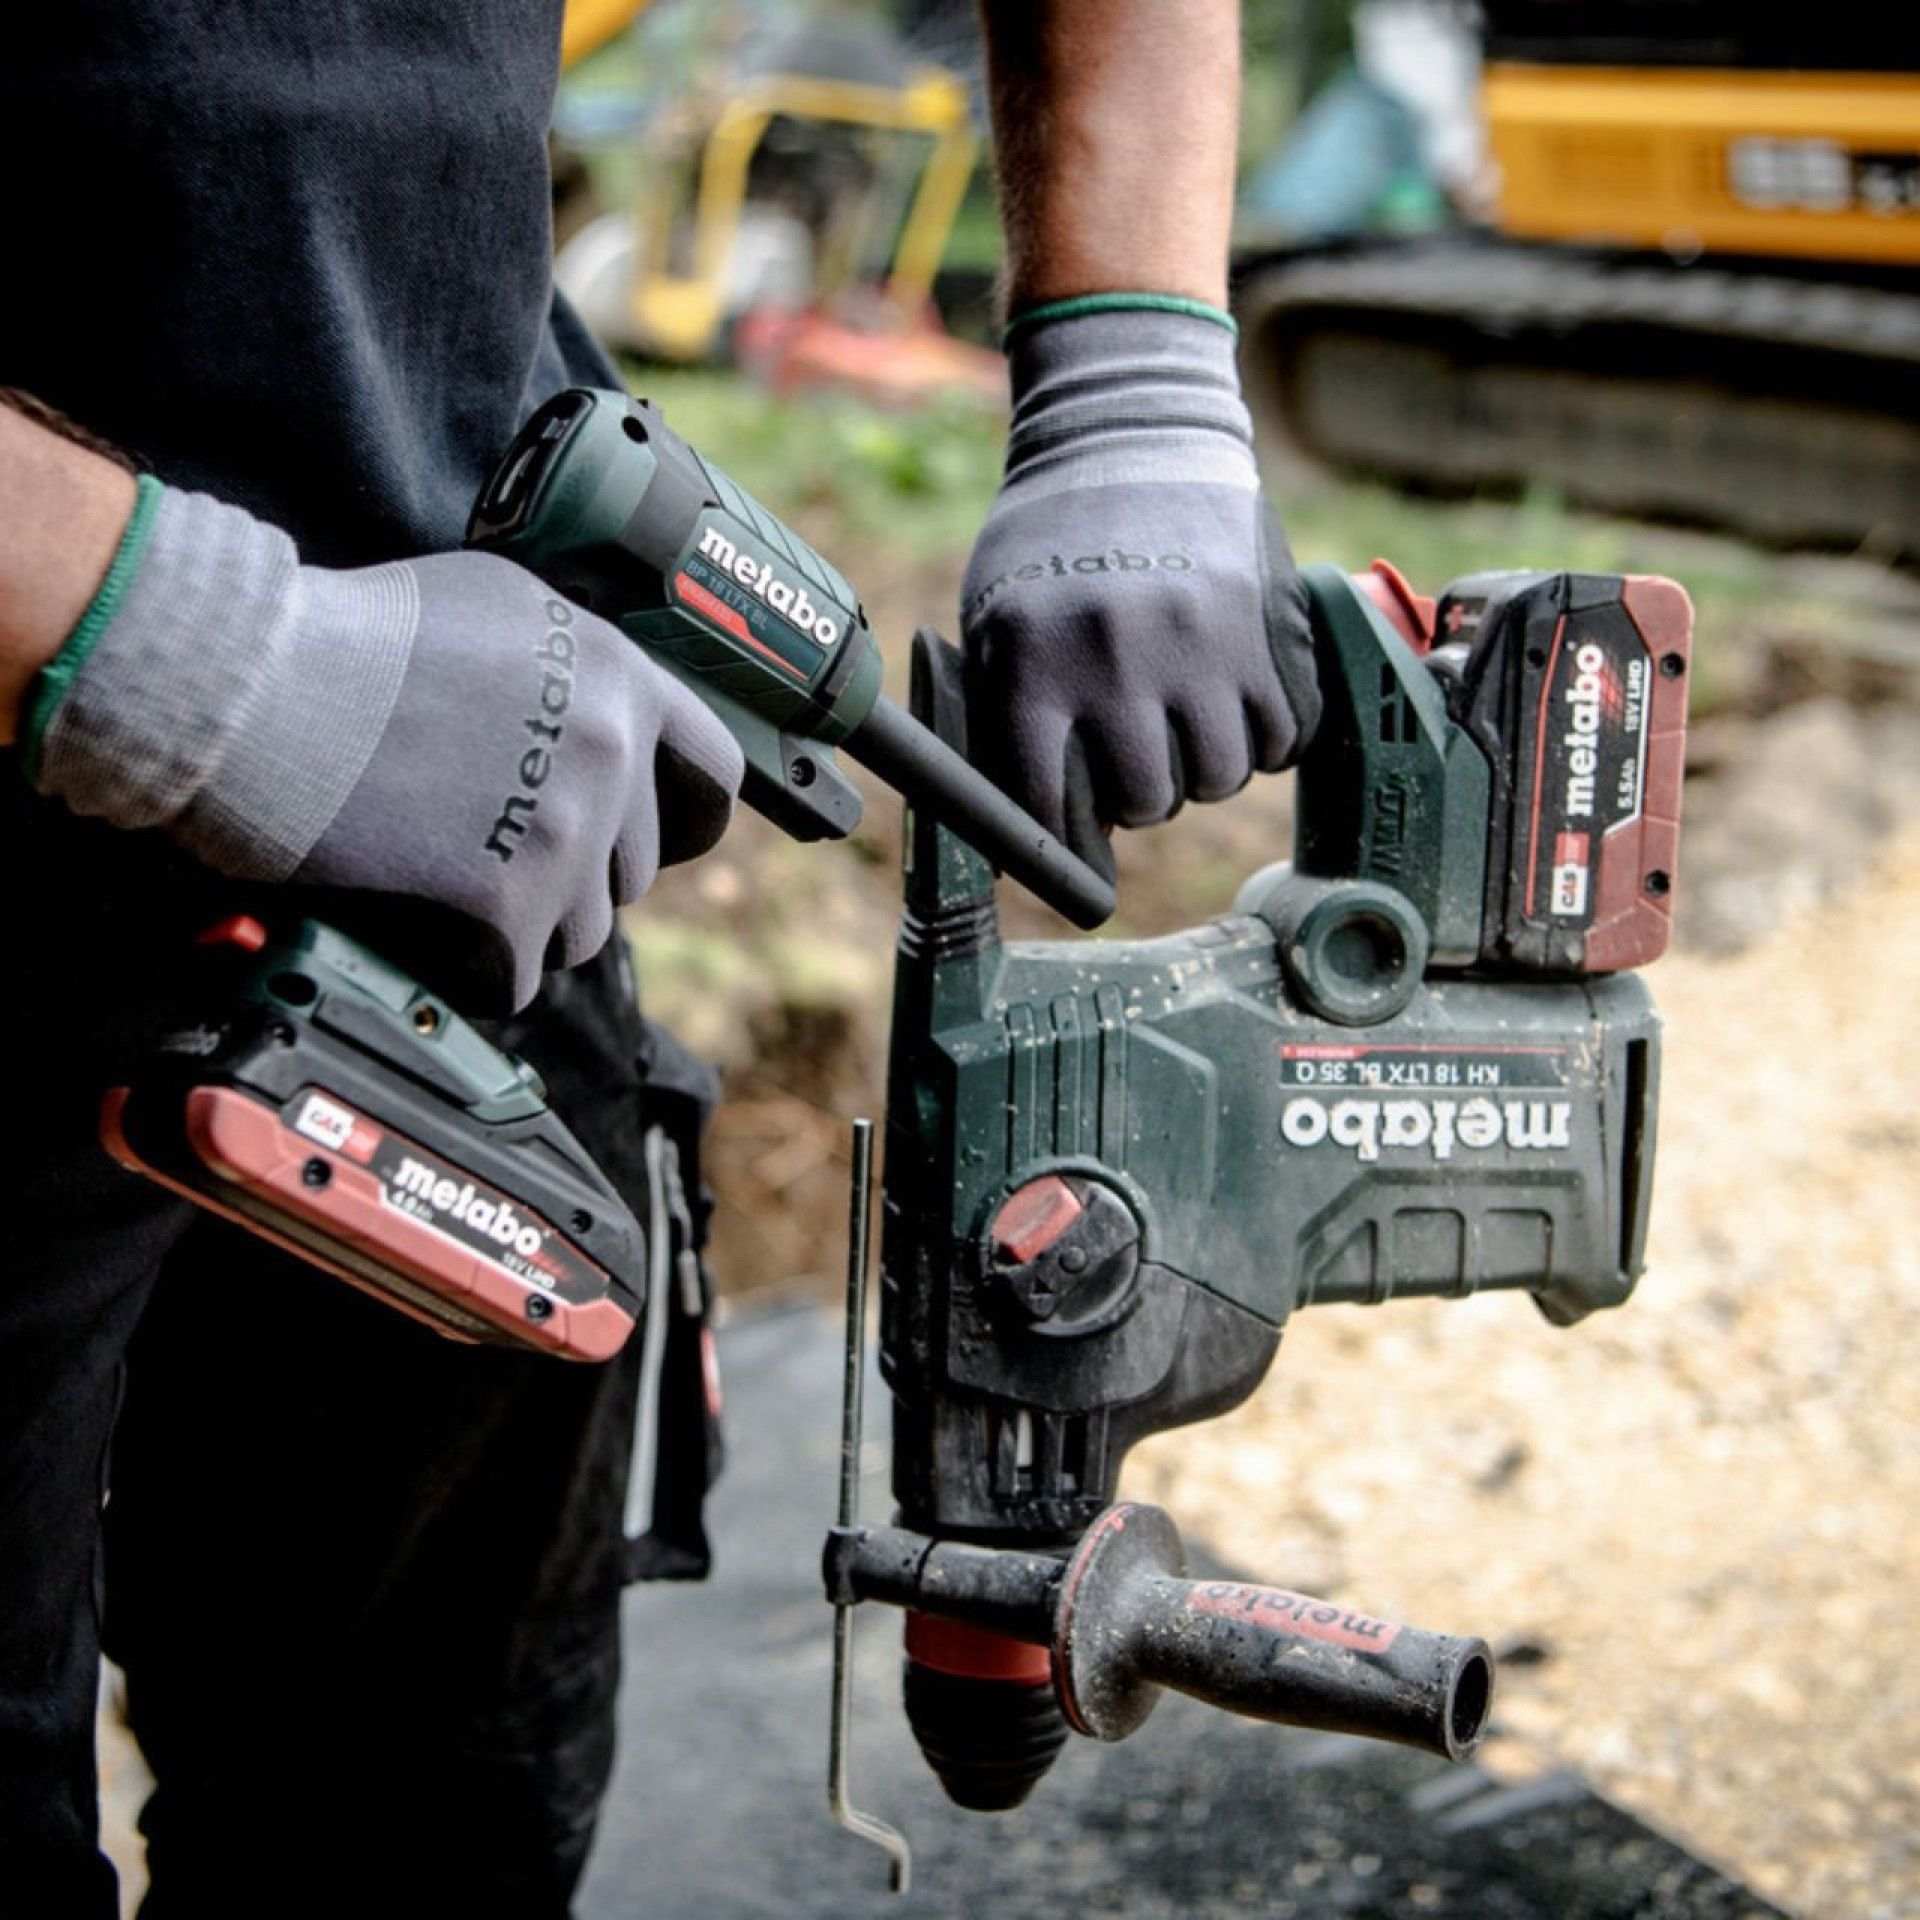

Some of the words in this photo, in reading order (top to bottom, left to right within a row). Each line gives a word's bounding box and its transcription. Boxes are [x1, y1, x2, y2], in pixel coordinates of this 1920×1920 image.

[698, 527, 838, 645] metabo
[485, 600, 573, 862] metabo
[1565, 643, 1603, 816] metabo
[1296, 1061, 1315, 1082] Q
[1320, 1062, 1347, 1082] 35
[1388, 1062, 1429, 1083] LTX
[1434, 1064, 1460, 1083] 18
[1467, 1064, 1500, 1084] KH
[1281, 1098, 1570, 1161] metabo
[392, 1157, 542, 1255] metabo
